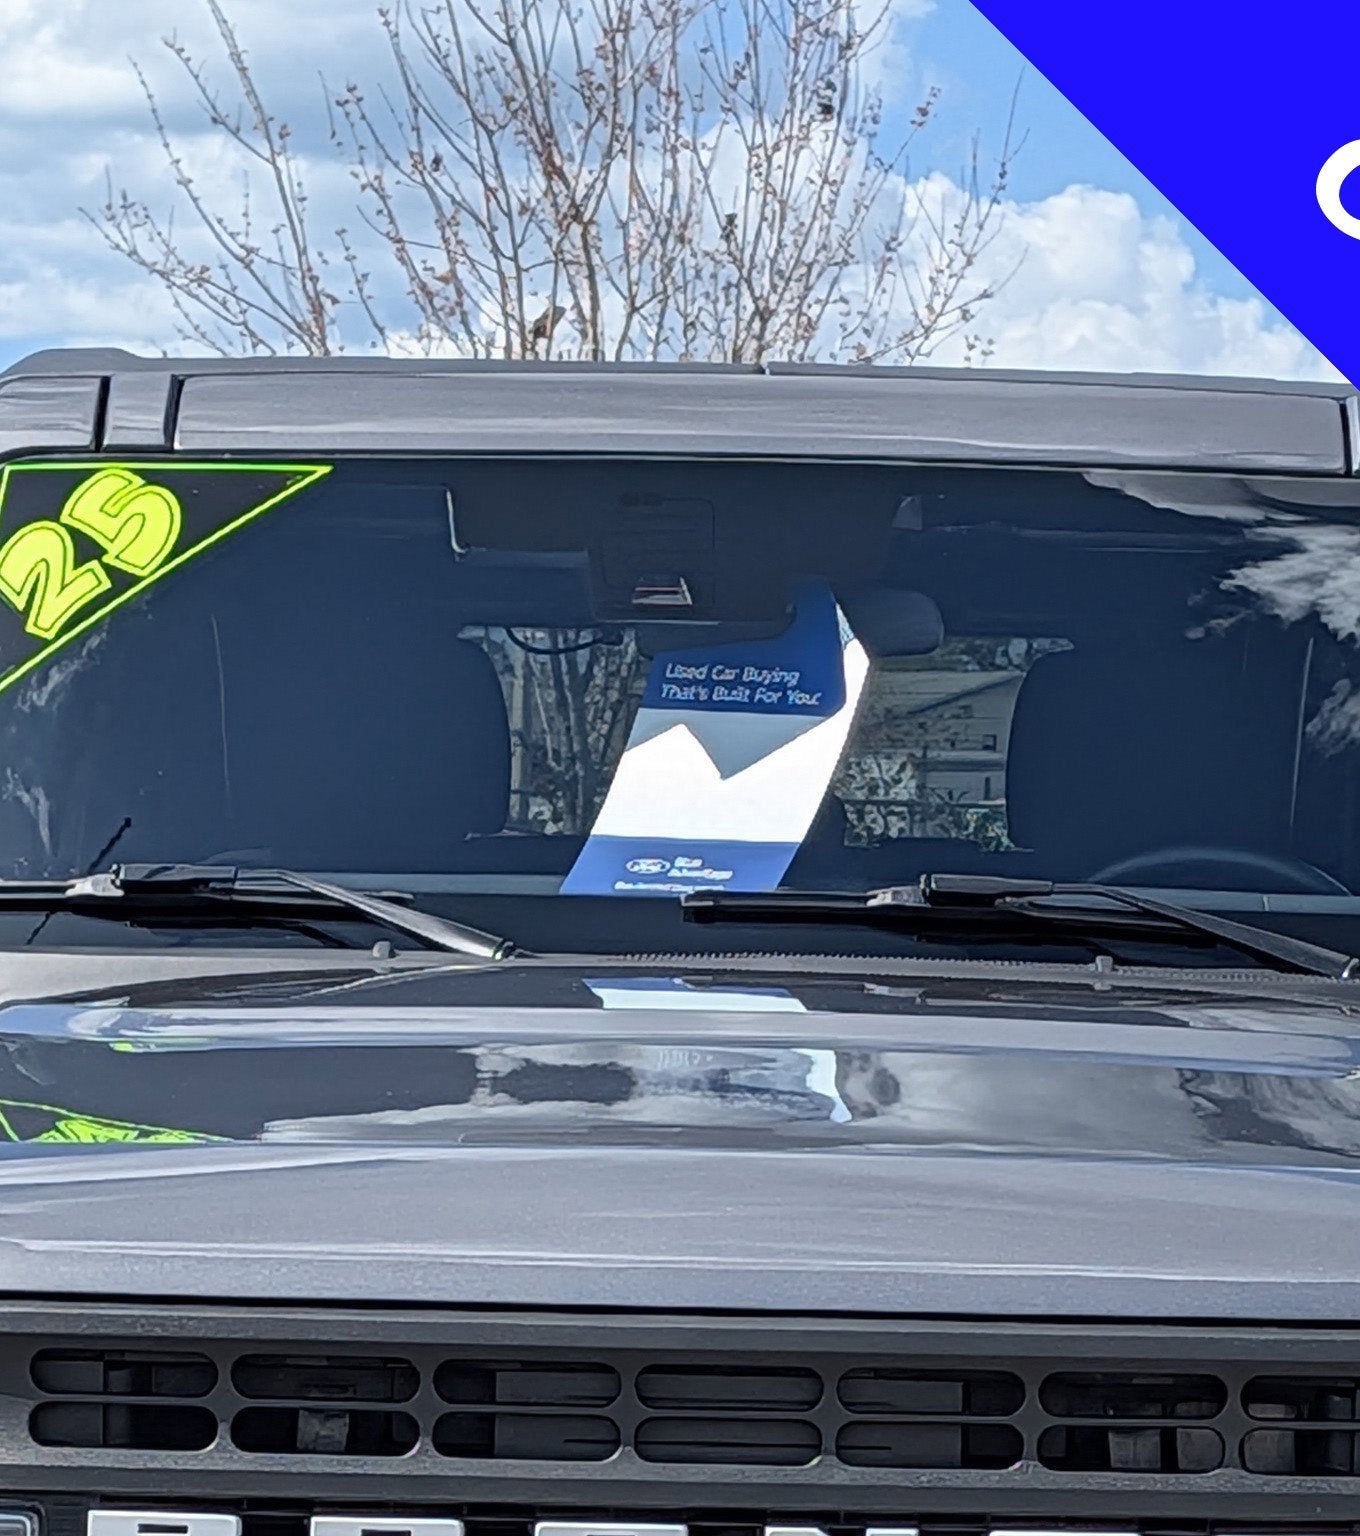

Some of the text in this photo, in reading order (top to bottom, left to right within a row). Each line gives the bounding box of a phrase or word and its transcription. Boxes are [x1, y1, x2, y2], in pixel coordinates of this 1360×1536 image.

[711, 664, 740, 681] Car
[742, 666, 801, 688] Buying
[712, 685, 750, 703] Built
